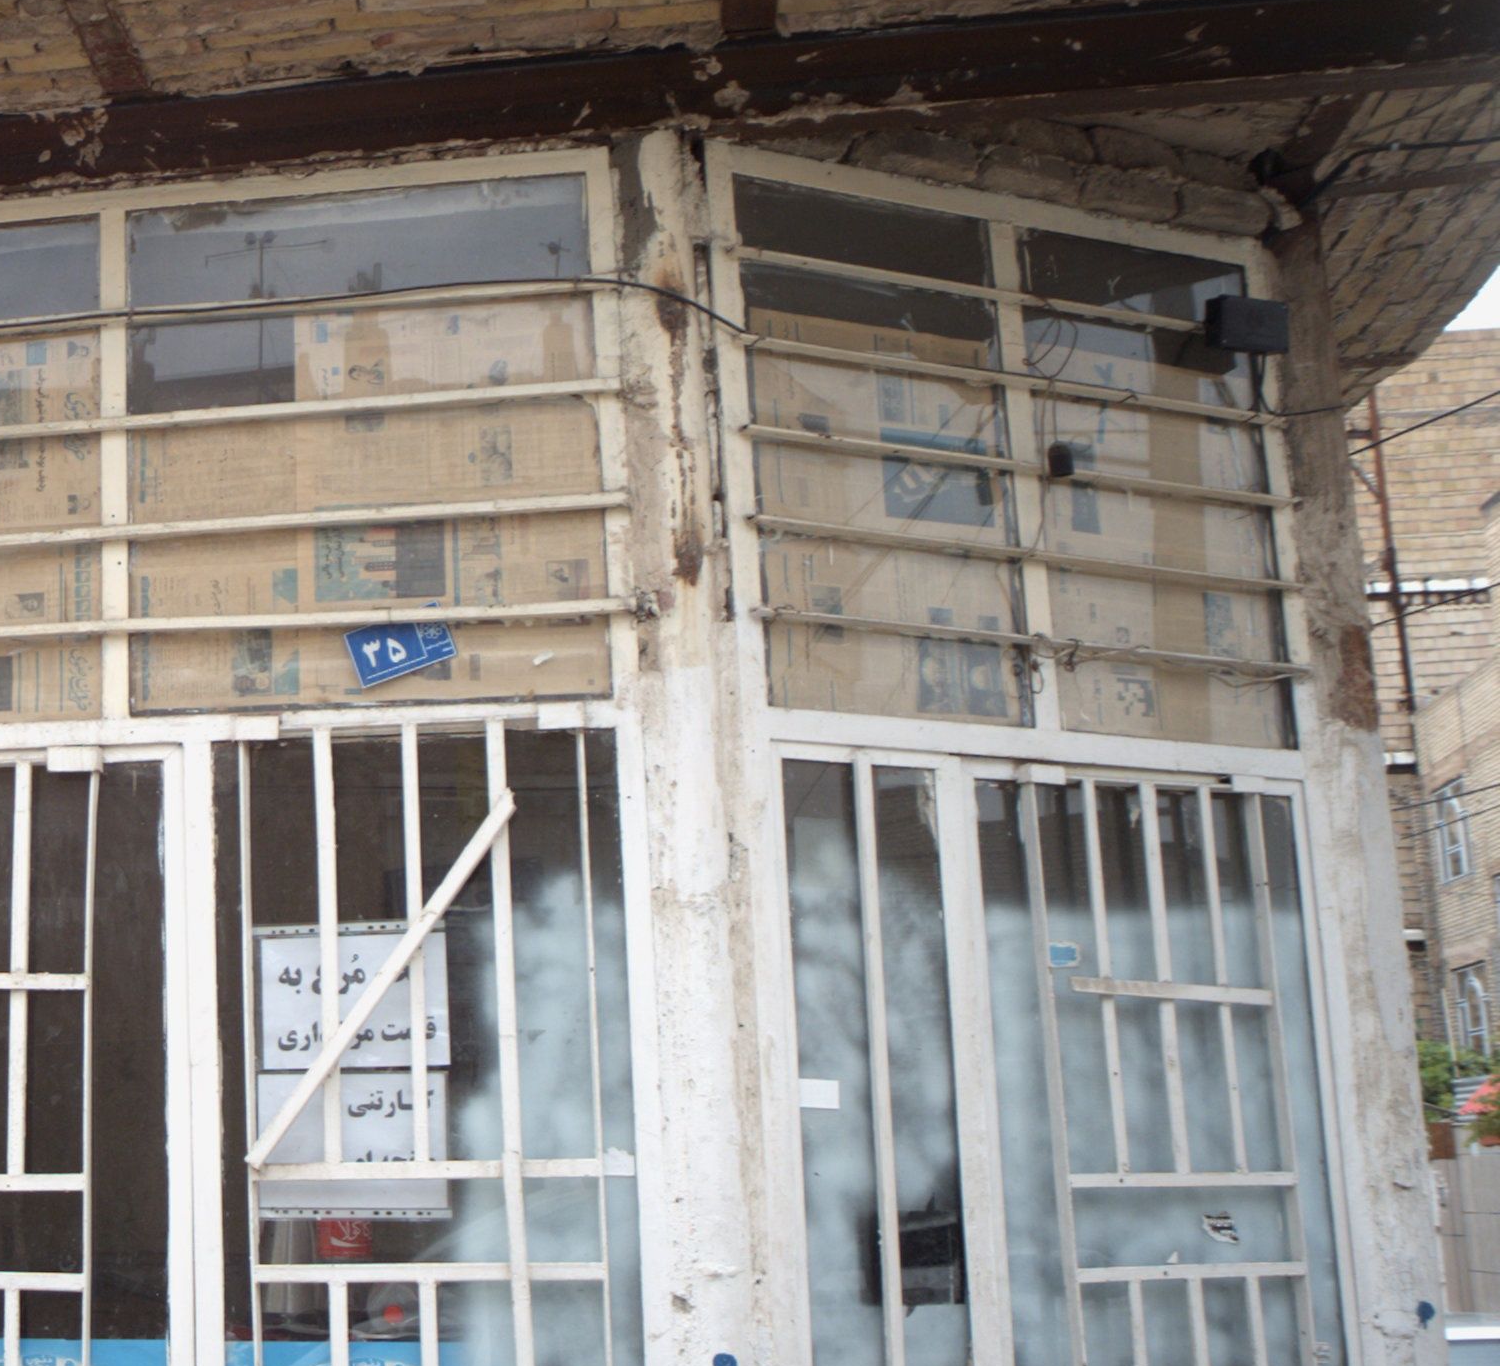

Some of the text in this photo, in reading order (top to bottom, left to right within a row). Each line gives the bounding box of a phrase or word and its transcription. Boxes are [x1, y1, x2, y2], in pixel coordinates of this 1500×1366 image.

[362, 636, 408, 668] ۳۵
[277, 965, 303, 996] به
[277, 1015, 438, 1052] قمت مراری
